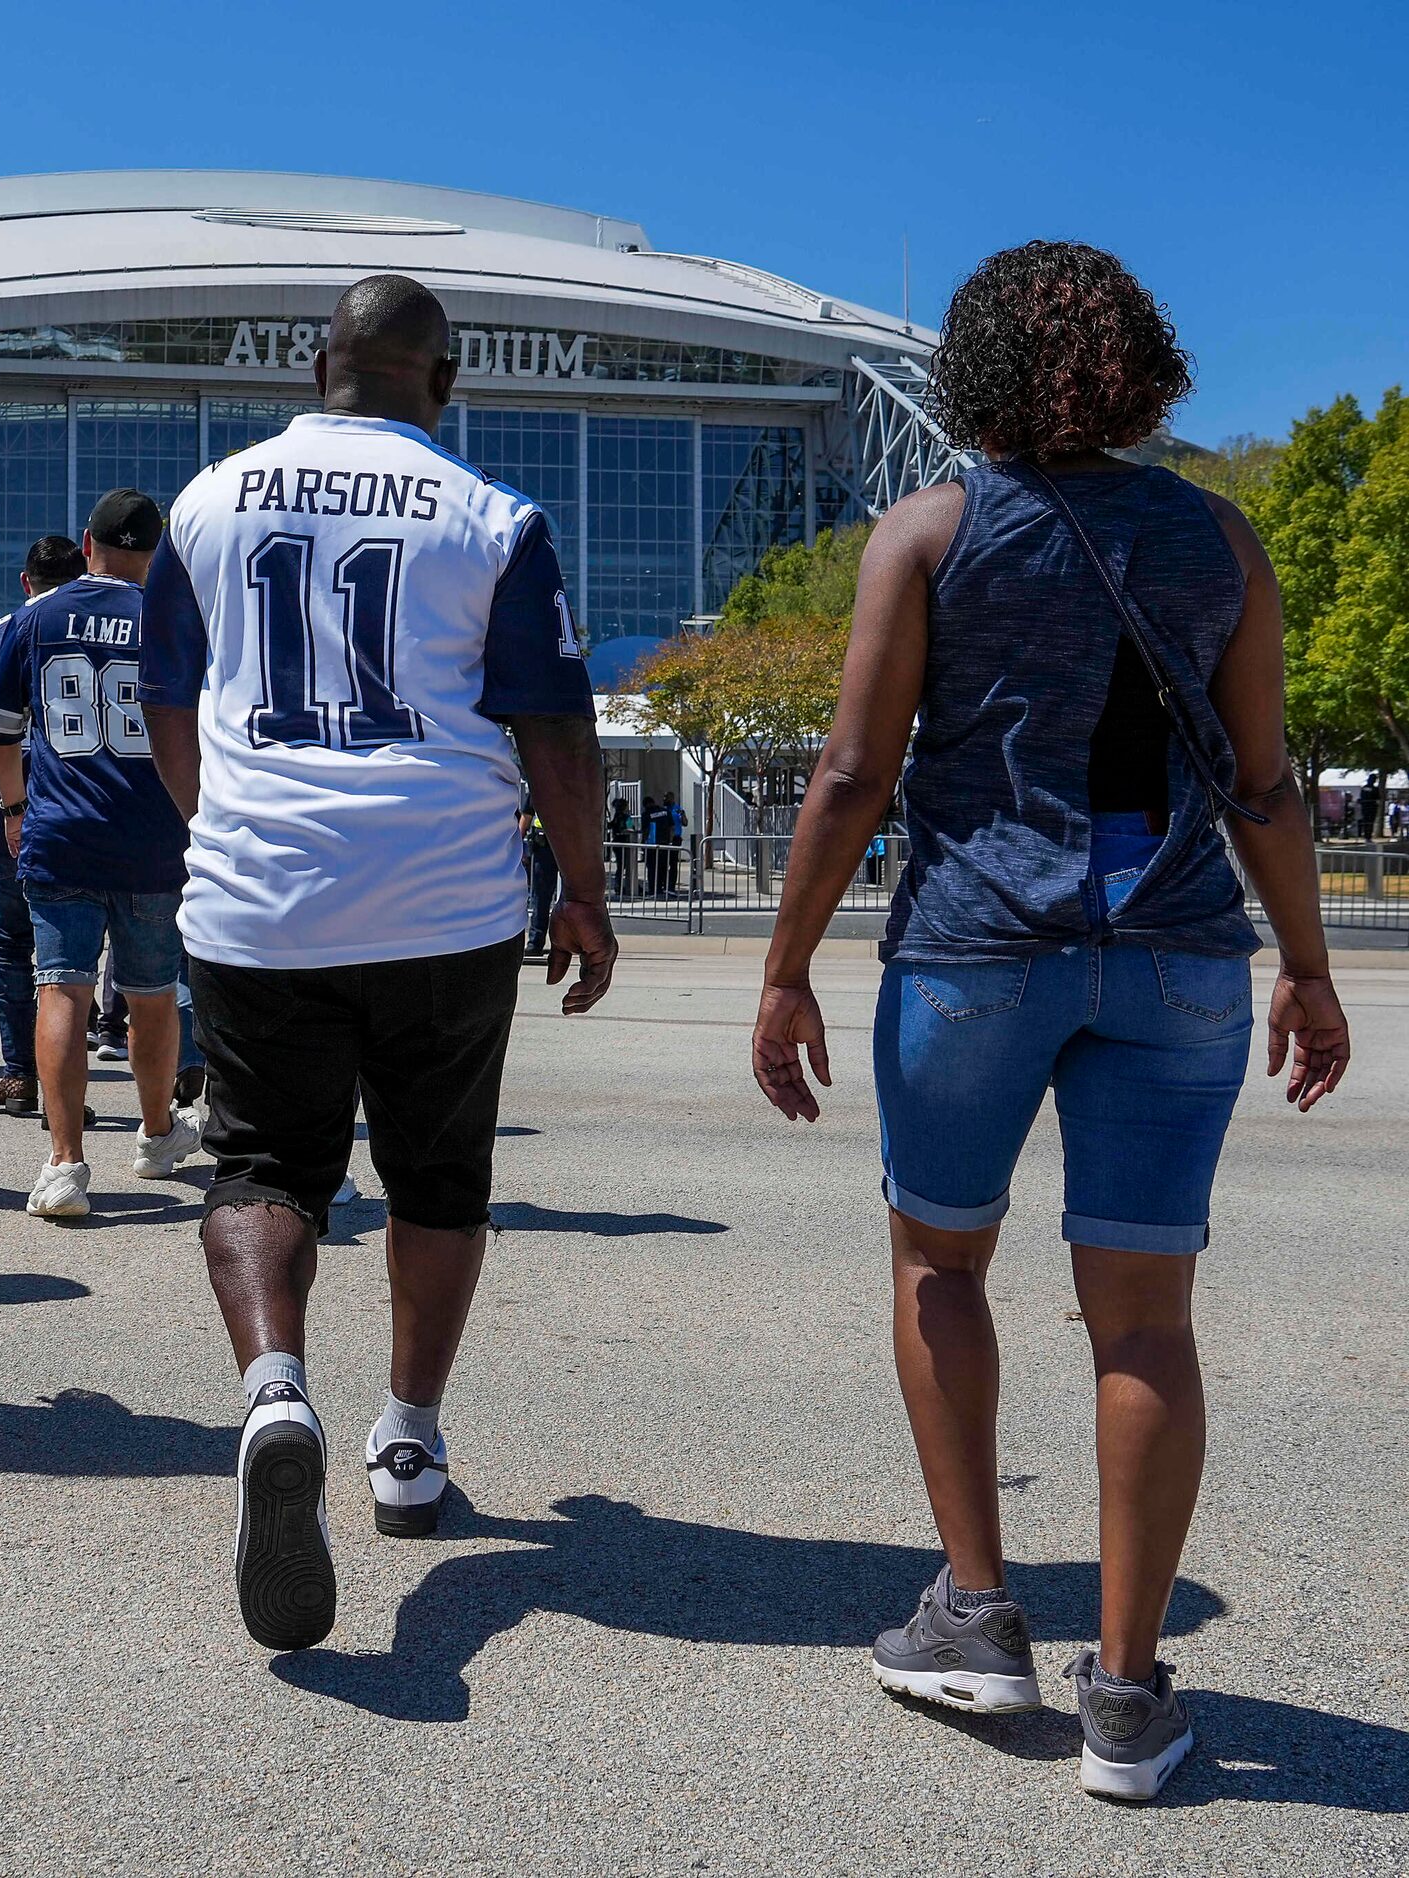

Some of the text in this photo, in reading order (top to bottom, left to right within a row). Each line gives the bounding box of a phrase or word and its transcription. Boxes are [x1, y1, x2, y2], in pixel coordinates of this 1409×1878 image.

[224, 320, 588, 379] AT& DIUM
[235, 468, 441, 521] PARSONS
[66, 613, 133, 646] LAMB
[247, 531, 425, 750] 11
[41, 653, 153, 758] 88
[396, 1449, 413, 1458] NIKE
[1102, 1696, 1133, 1712] NIKE
